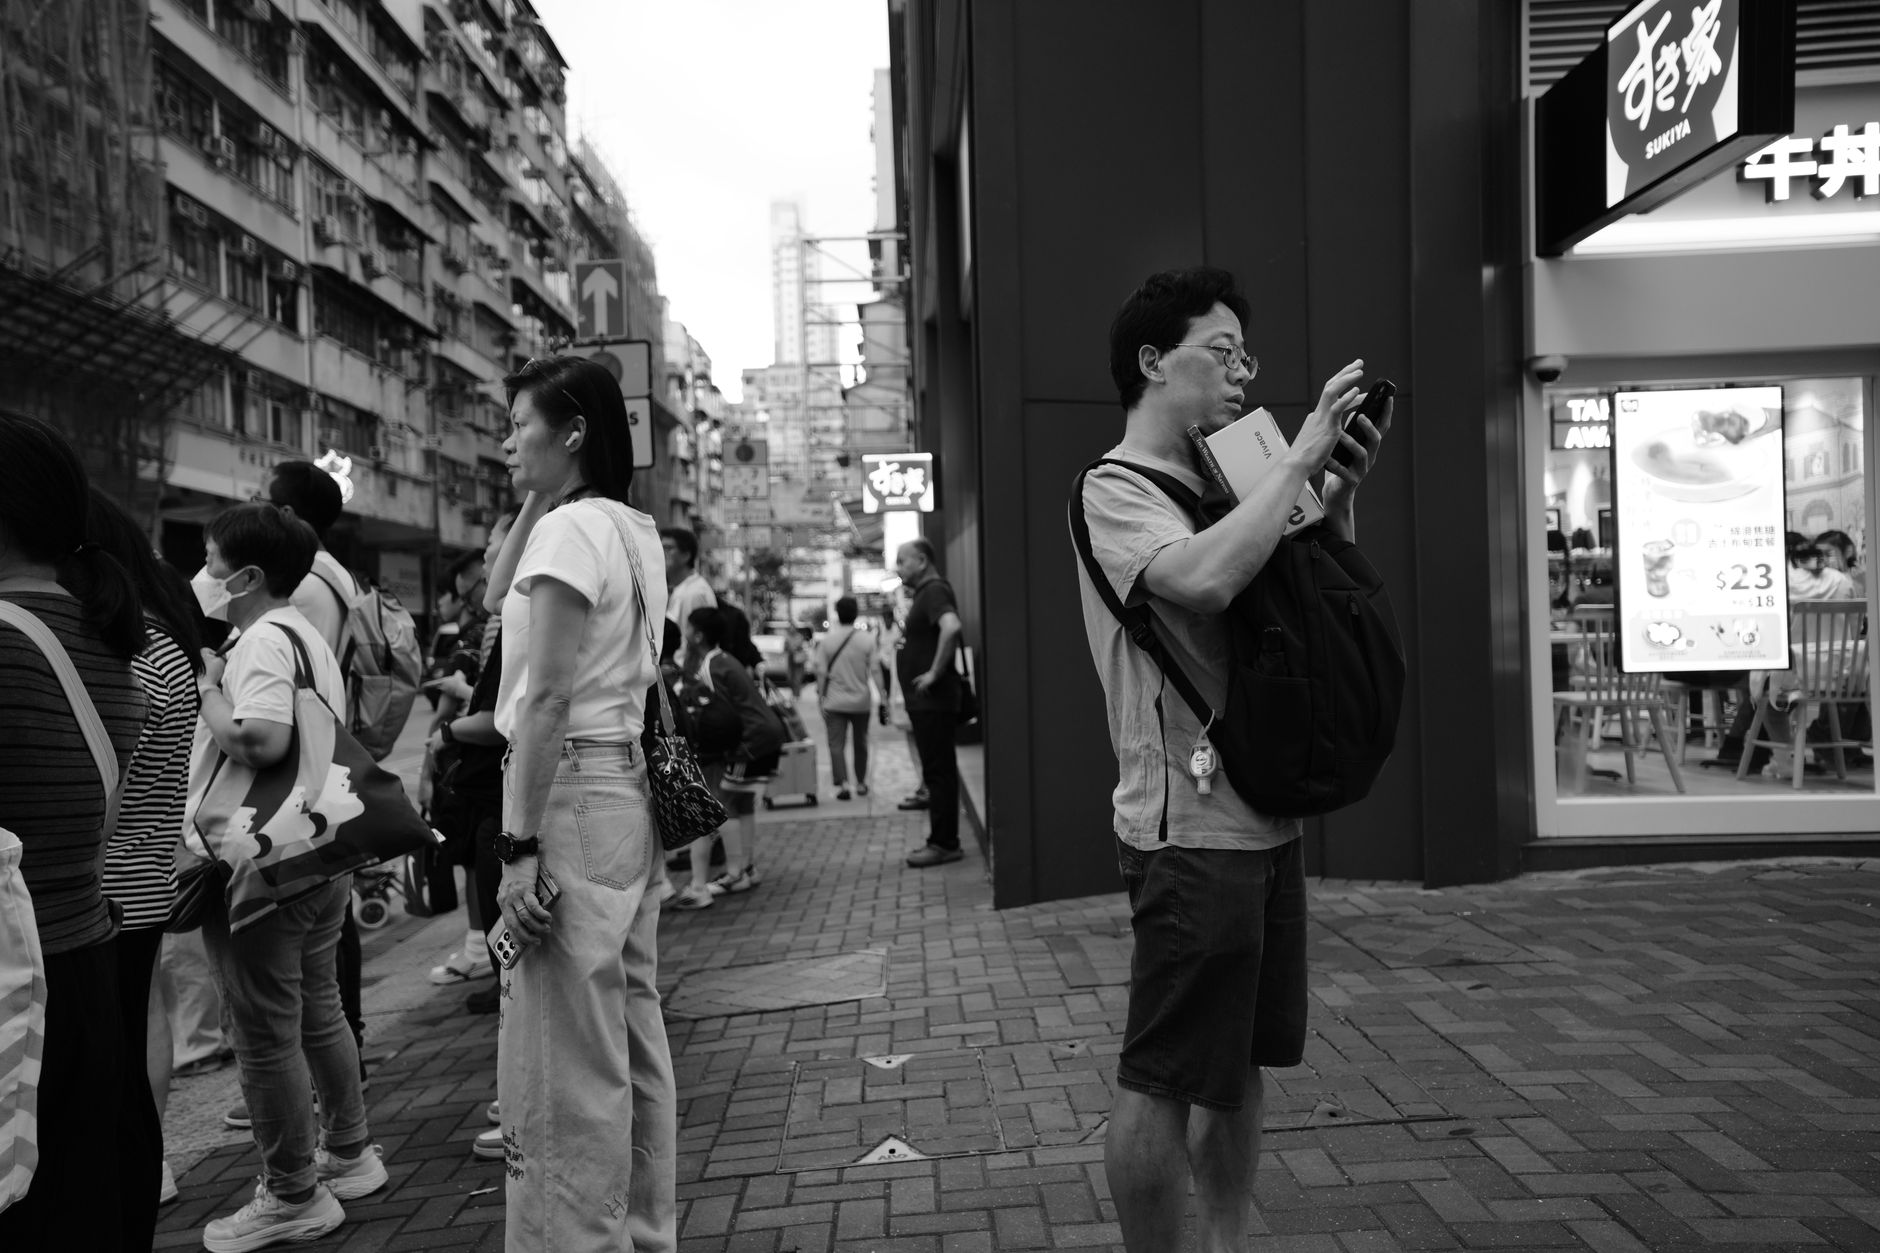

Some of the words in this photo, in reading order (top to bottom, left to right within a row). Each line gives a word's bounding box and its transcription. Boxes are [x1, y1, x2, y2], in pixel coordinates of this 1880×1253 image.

[1617, 0, 1722, 131] すき家
[1645, 118, 1691, 160] SUKIYA
[1254, 430, 1272, 460] Vivace
[1716, 563, 1773, 590] $23
